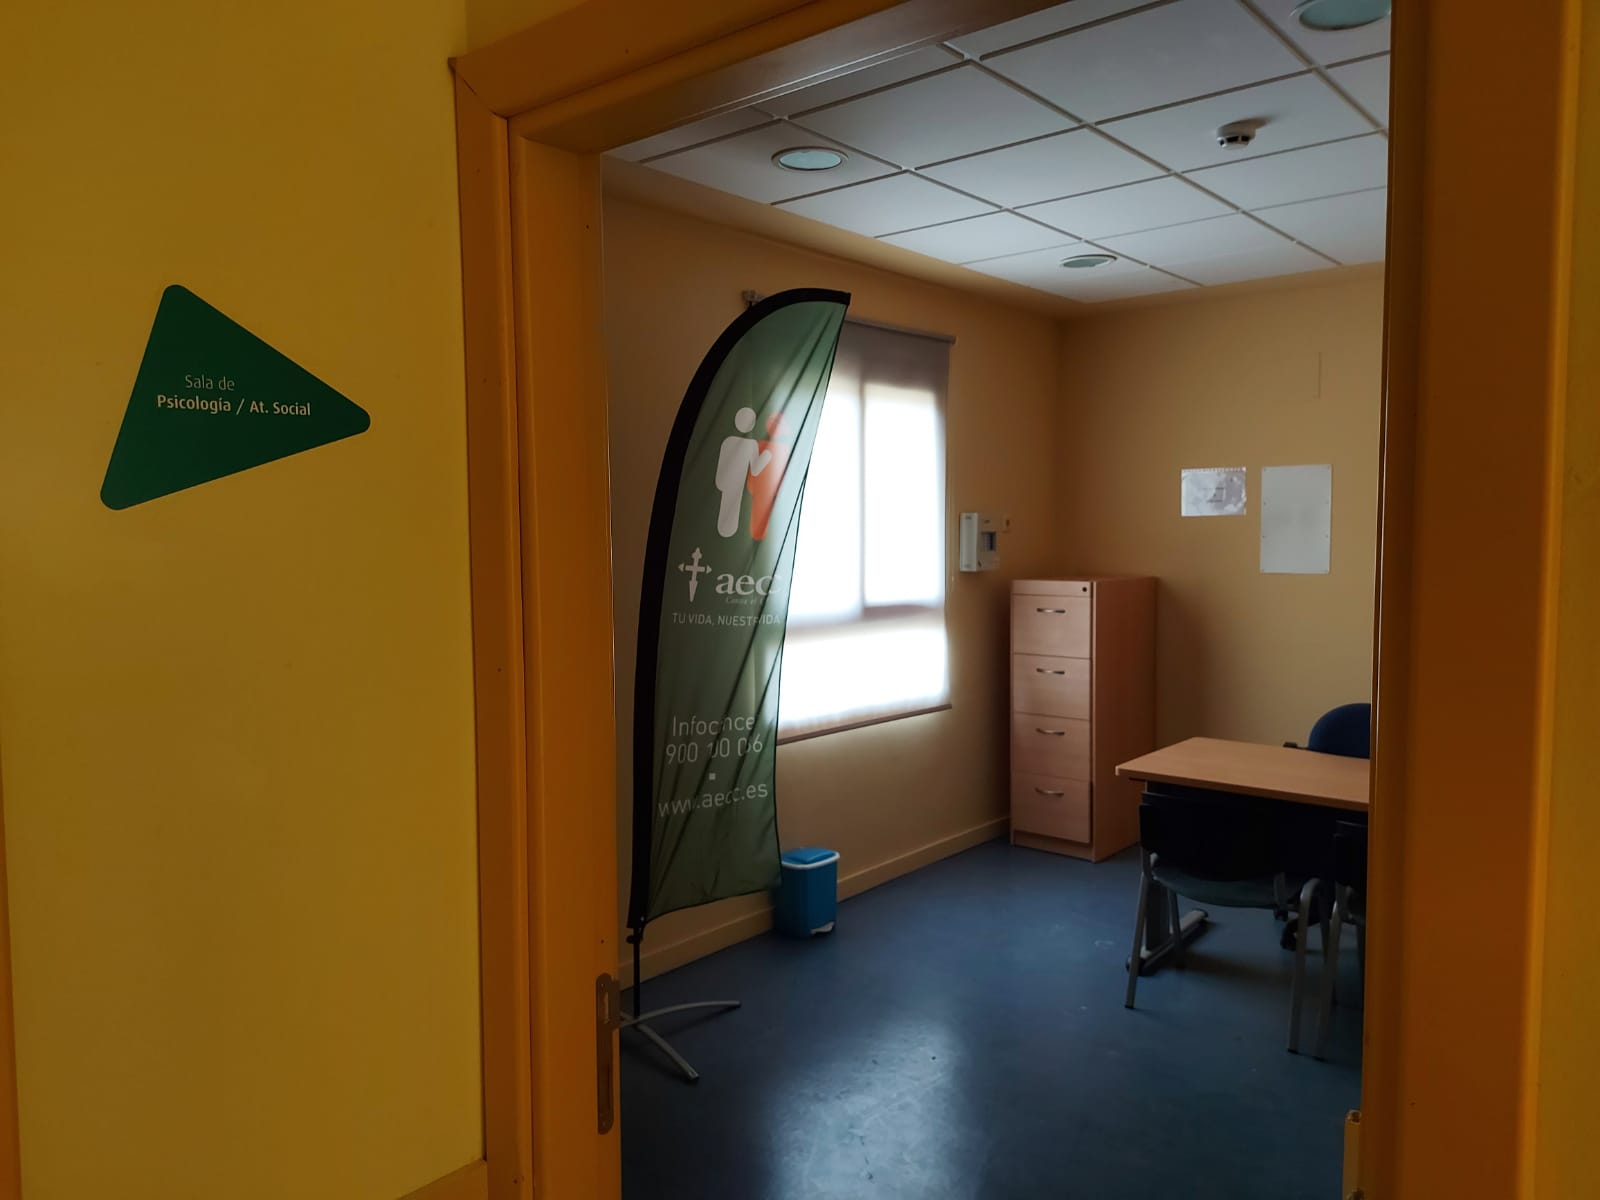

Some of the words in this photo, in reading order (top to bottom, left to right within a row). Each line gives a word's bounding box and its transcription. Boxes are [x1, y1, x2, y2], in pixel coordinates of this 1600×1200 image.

[185, 374, 214, 390] Sala
[218, 376, 235, 391] de
[157, 394, 231, 415] Psicología
[250, 400, 269, 414] At.
[273, 401, 311, 416] Social
[717, 615, 758, 627] NUEST
[665, 741, 698, 765] 900
